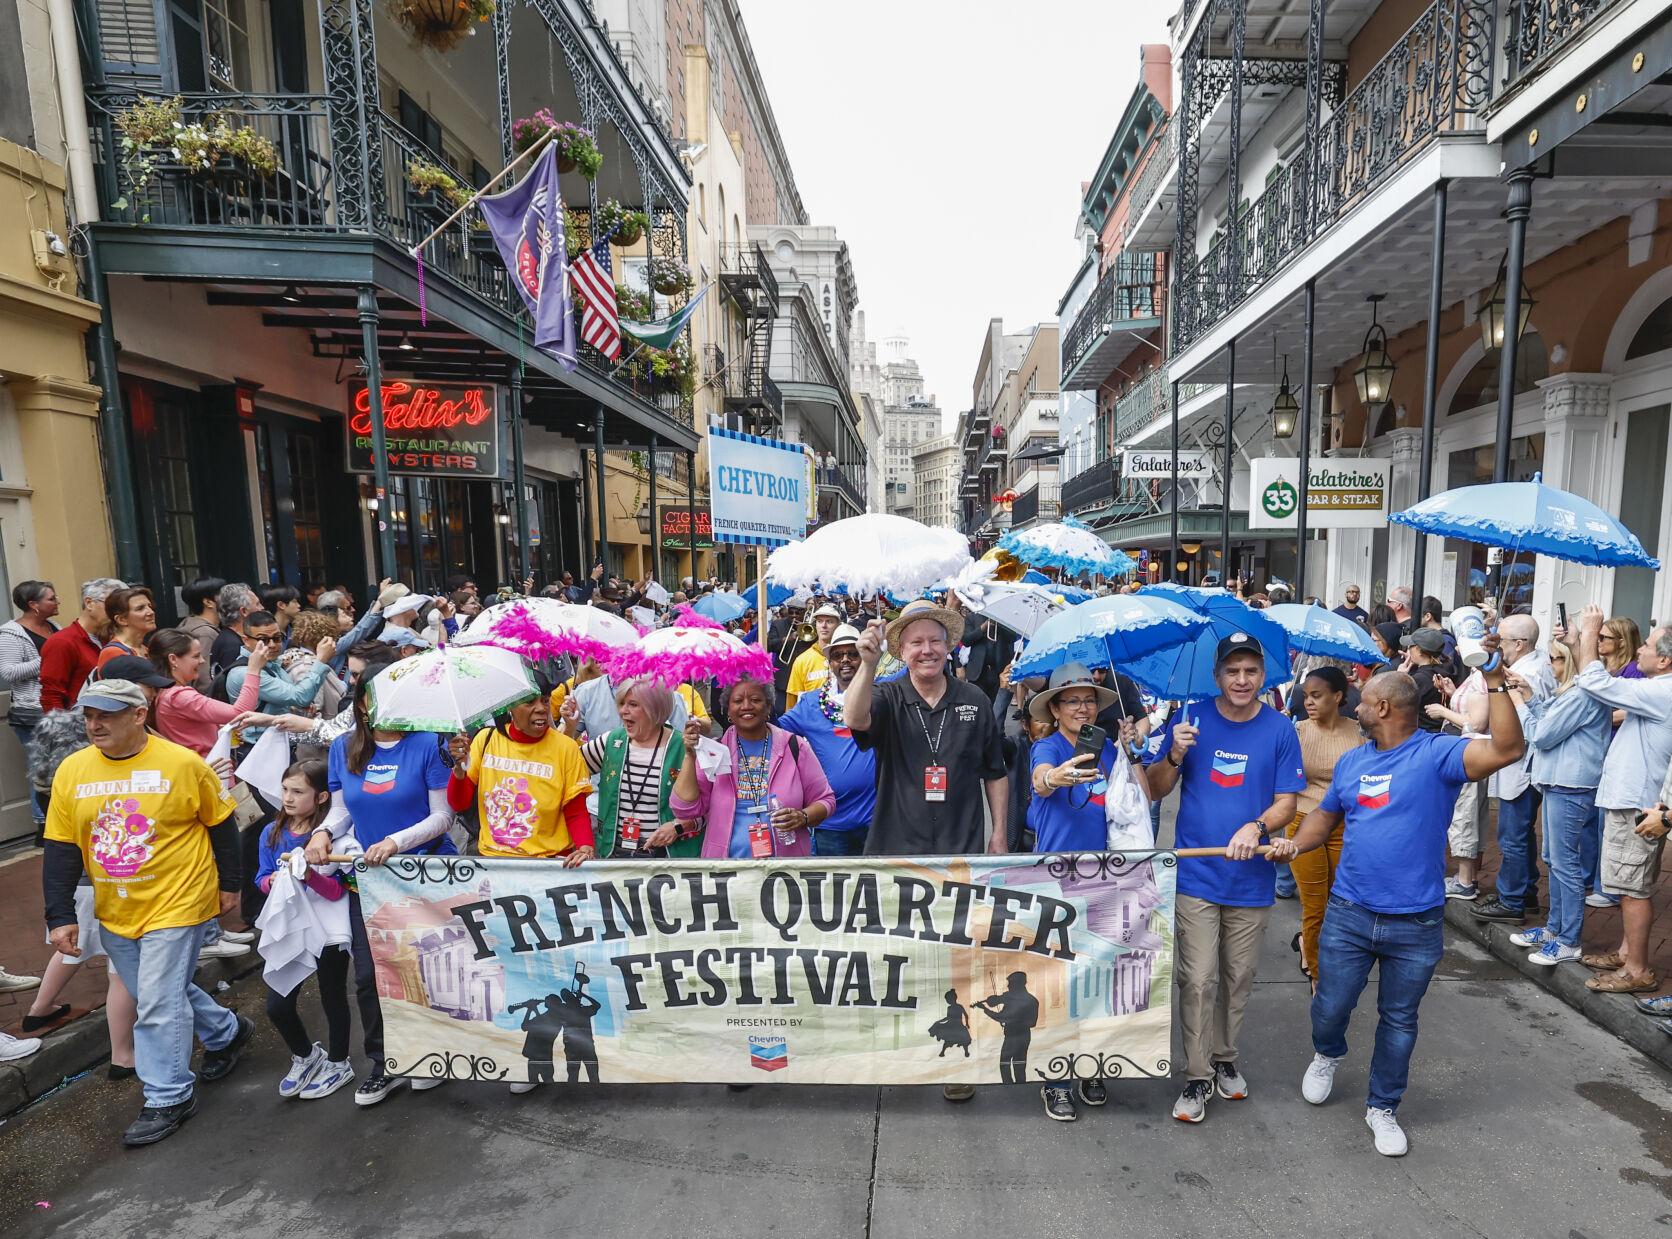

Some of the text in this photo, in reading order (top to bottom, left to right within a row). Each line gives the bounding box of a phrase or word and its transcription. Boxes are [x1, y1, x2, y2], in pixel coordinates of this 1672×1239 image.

[521, 252, 539, 294] PELIC
[823, 283, 831, 342] ASTO
[351, 382, 492, 434] Felix's
[355, 436, 490, 454] RSTAURANT
[370, 453, 476, 469] YSTERS
[1132, 454, 1206, 472] Galatore's
[718, 464, 799, 502] CHEVRON
[1308, 467, 1384, 488] alatoire's
[1266, 489, 1293, 511] 33
[1307, 494, 1379, 505] BAR & STEAK
[715, 517, 739, 530] FRENCH
[740, 520, 767, 532] QUARTER
[768, 523, 791, 535] FESTIVAL
[1214, 749, 1249, 761] Chevron
[1360, 774, 1392, 782] Chevron
[451, 871, 1077, 961] FRENCH QUARTER
[611, 947, 917, 1010] FESTIVAL
[727, 1018, 803, 1027] PRESENTED BY
[748, 1035, 786, 1044] Chevron
